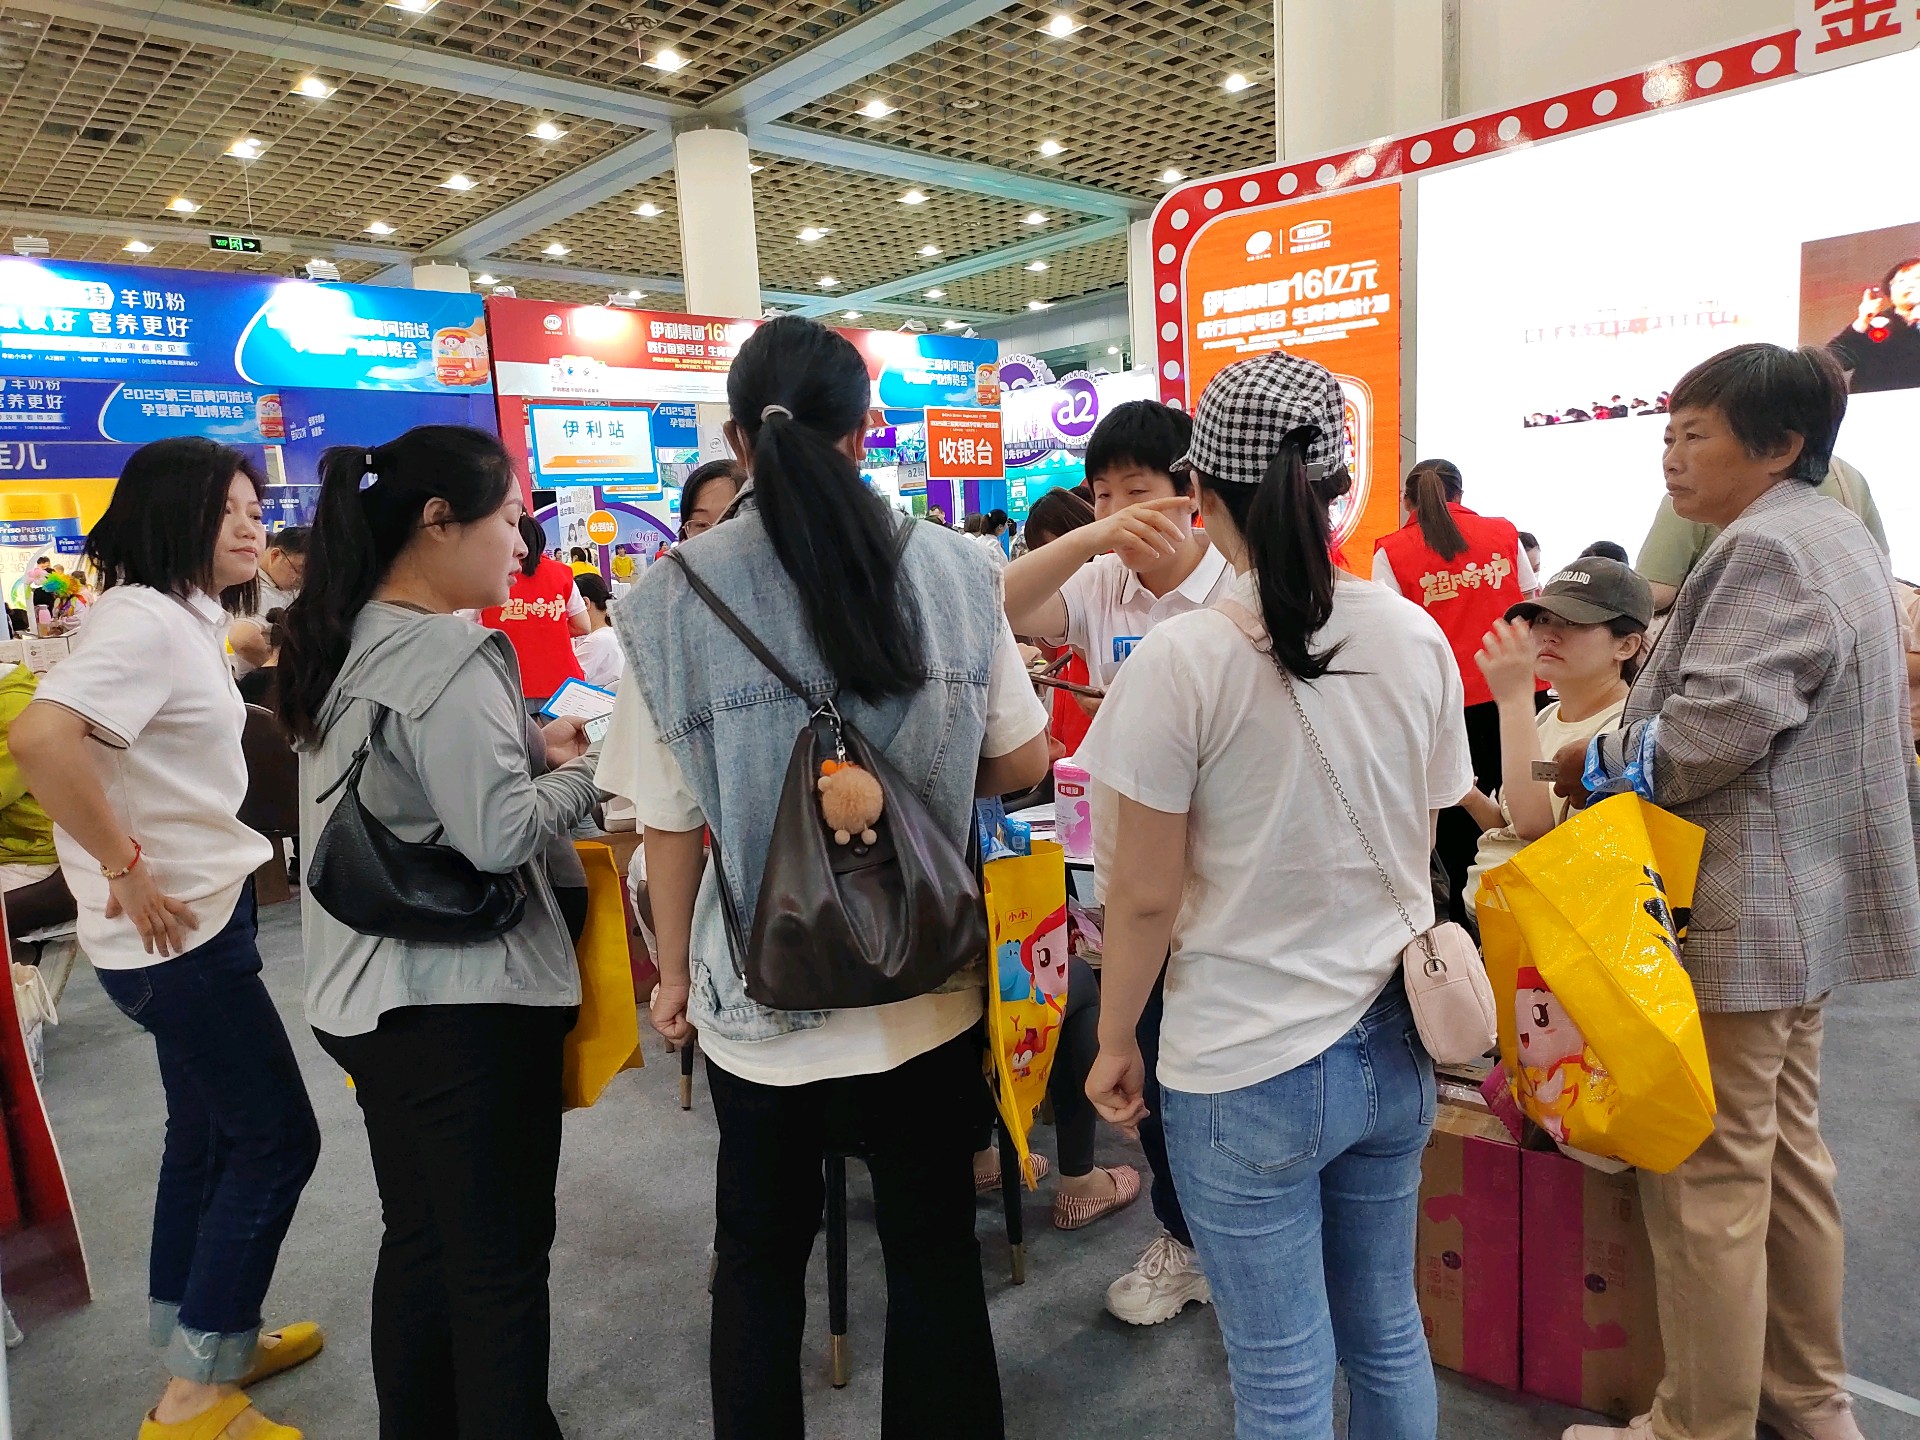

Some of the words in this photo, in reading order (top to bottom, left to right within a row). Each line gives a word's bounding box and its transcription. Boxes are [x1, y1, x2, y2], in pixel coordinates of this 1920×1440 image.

[1814, 0, 1920, 54] 金
[120, 289, 186, 312] 羊奶粉
[88, 311, 189, 338] 营养更好
[650, 321, 729, 342] 伊利集团16
[123, 388, 254, 404] 2025第三届黄河流域
[141, 404, 244, 419] 孕婴童产业博览会
[1056, 391, 1095, 425] a2
[563, 420, 625, 438] 伊利站
[939, 438, 993, 465] 收银台
[590, 522, 614, 533] 必到站
[1419, 553, 1510, 607] 超凡守护
[500, 594, 566, 622] 超凡守护
[1008, 909, 1029, 922] 小小
